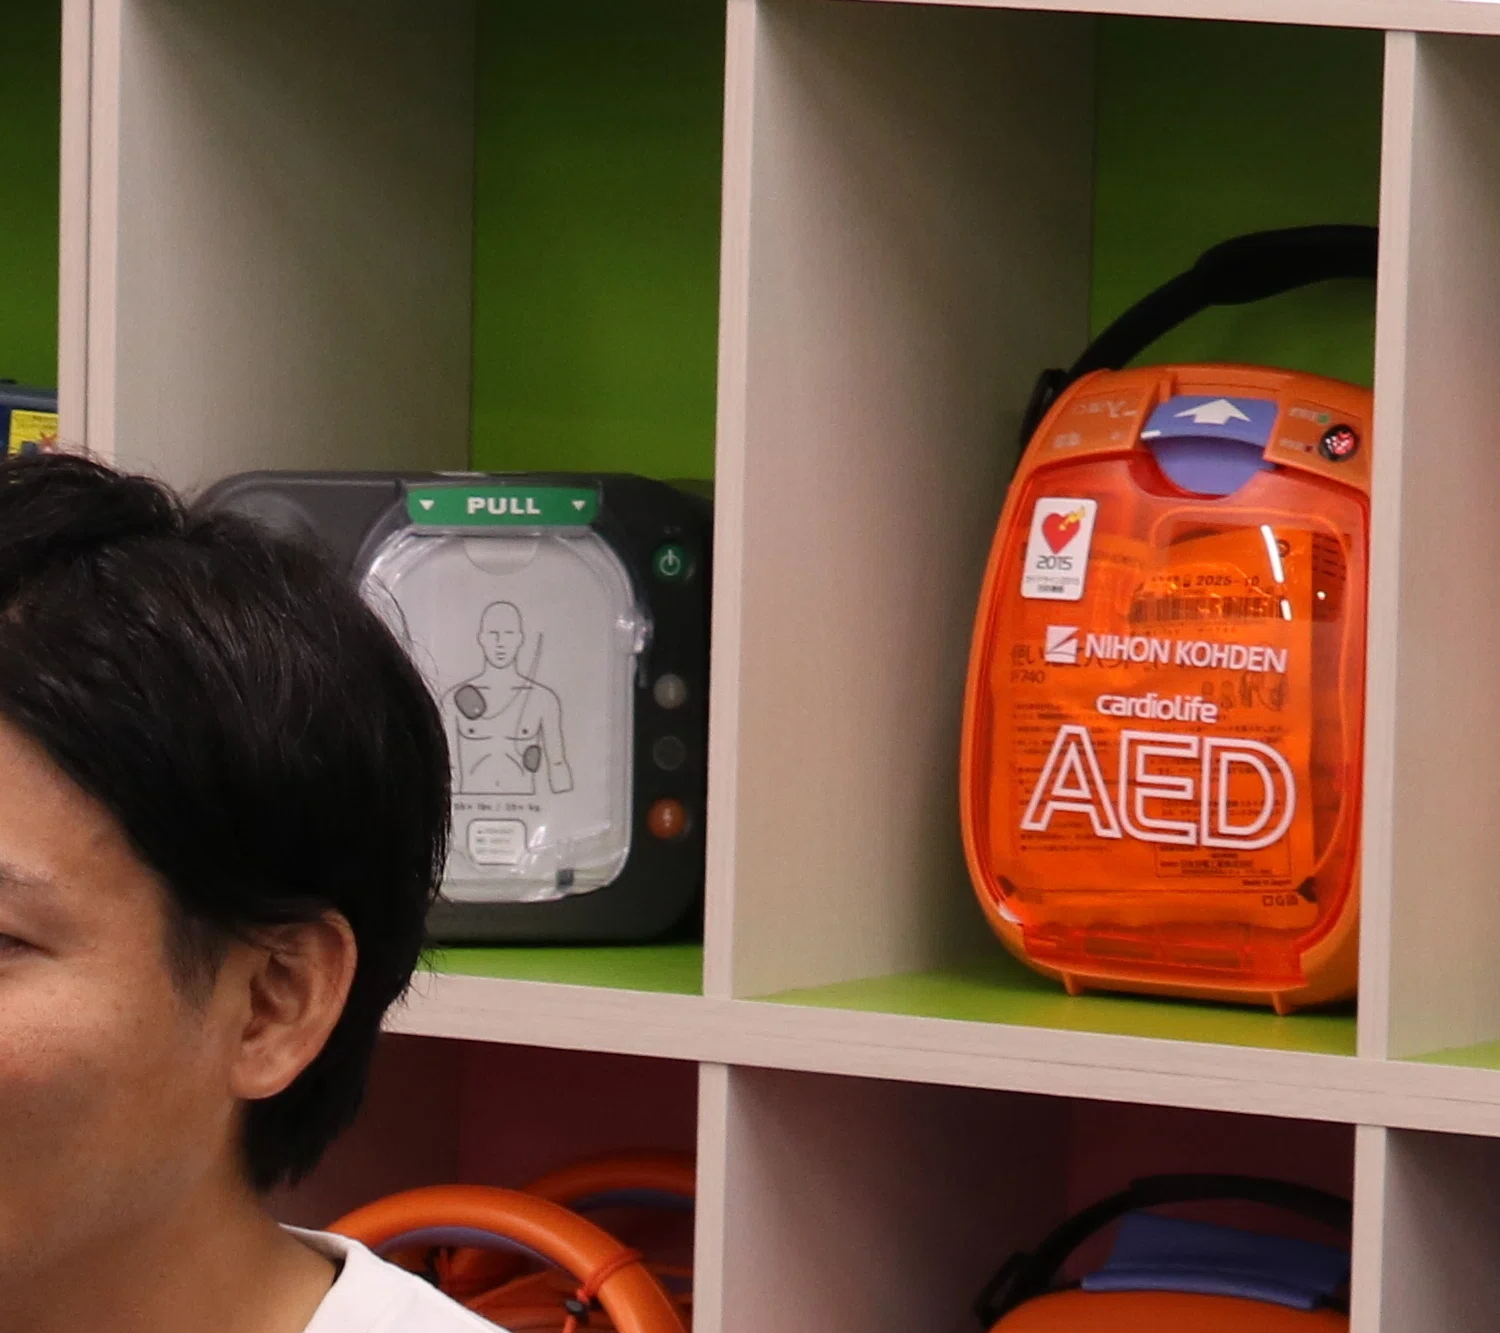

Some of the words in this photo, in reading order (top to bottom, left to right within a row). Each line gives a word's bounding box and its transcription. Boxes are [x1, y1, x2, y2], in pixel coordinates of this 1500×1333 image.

[466, 496, 541, 515] PULL
[1085, 633, 1169, 663] NIHON
[1174, 640, 1287, 674] KOHDEN
[1096, 692, 1218, 723] cardiolife
[1019, 724, 1296, 850] AED
